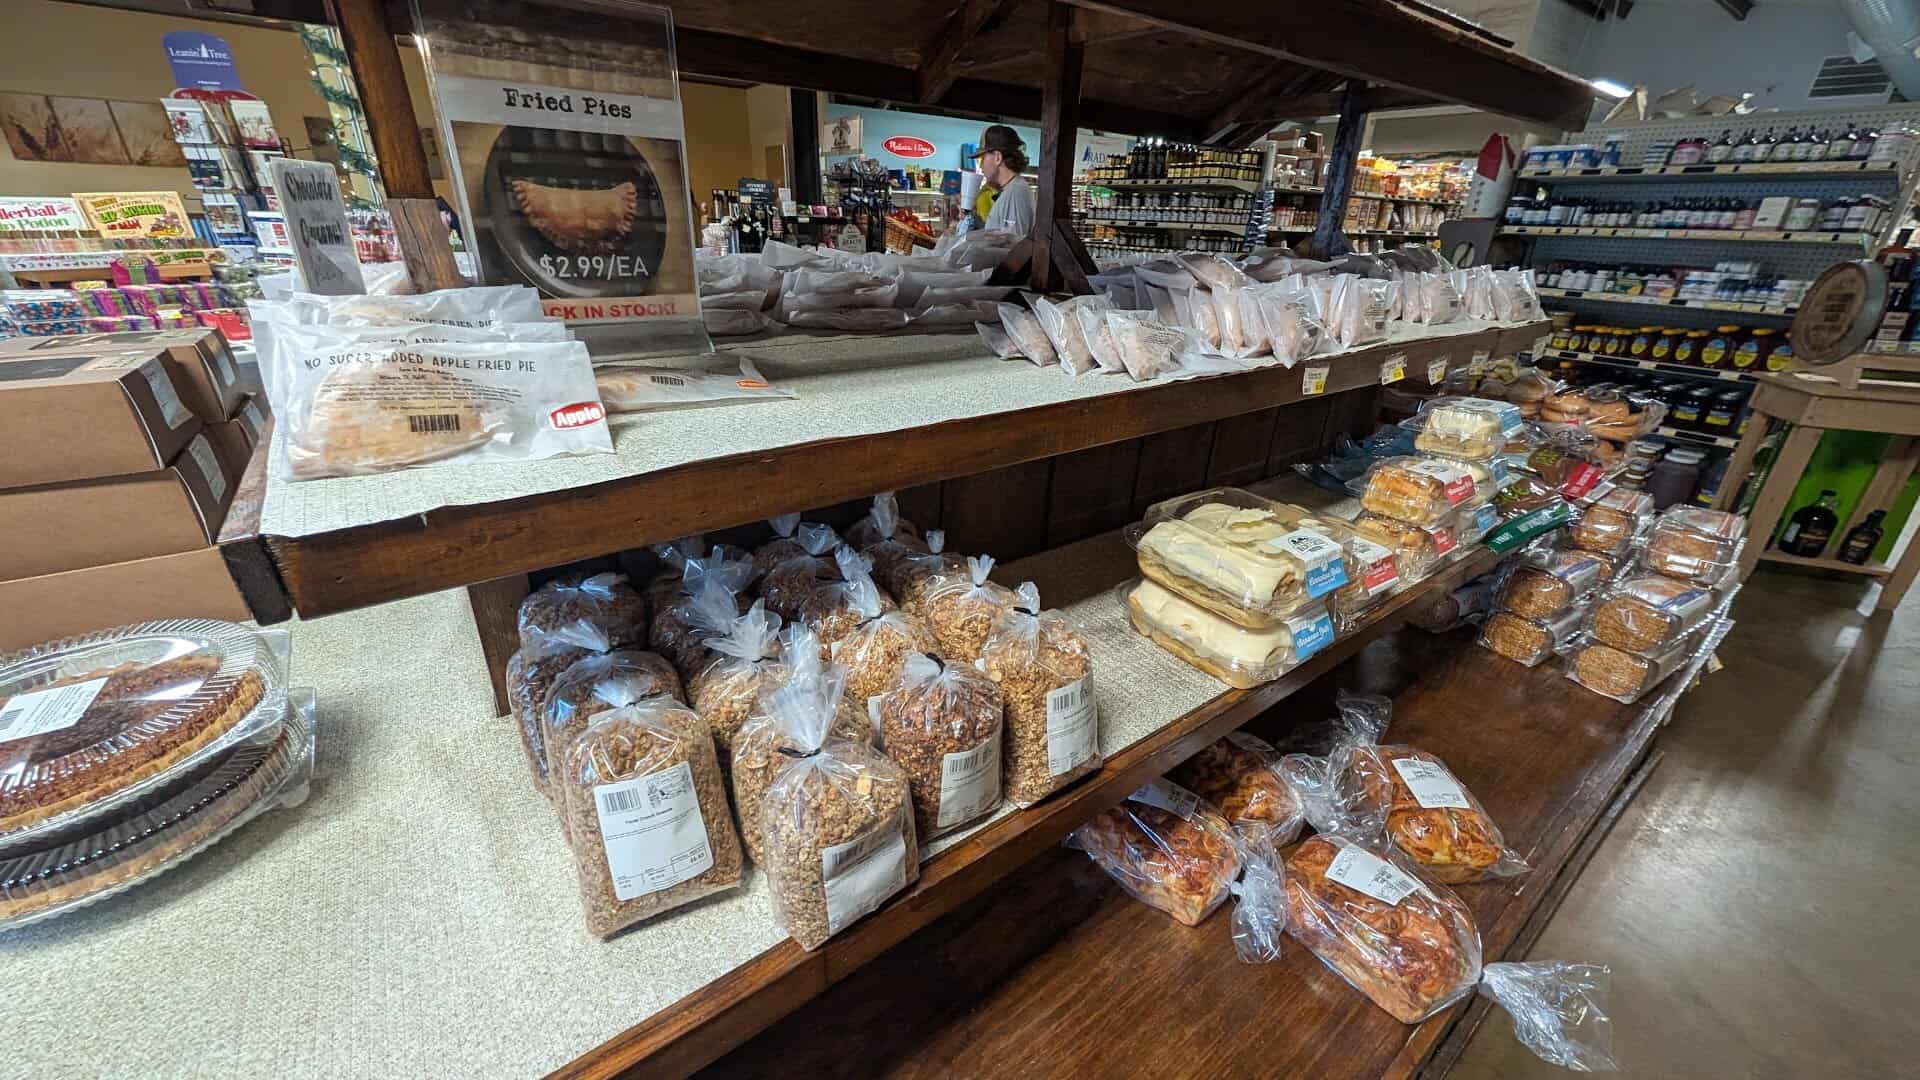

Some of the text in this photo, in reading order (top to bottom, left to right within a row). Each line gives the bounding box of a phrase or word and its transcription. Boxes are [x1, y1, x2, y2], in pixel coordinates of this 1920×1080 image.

[502, 87, 632, 119] Fried Pies
[284, 171, 333, 201] Chocolate
[540, 254, 649, 281] $2.99/EA
[584, 305, 604, 319] IN
[304, 357, 321, 369] NO
[432, 356, 472, 369] APPLE
[477, 359, 512, 371] FRIED
[518, 360, 537, 373] PIE
[556, 406, 601, 427] Apple
